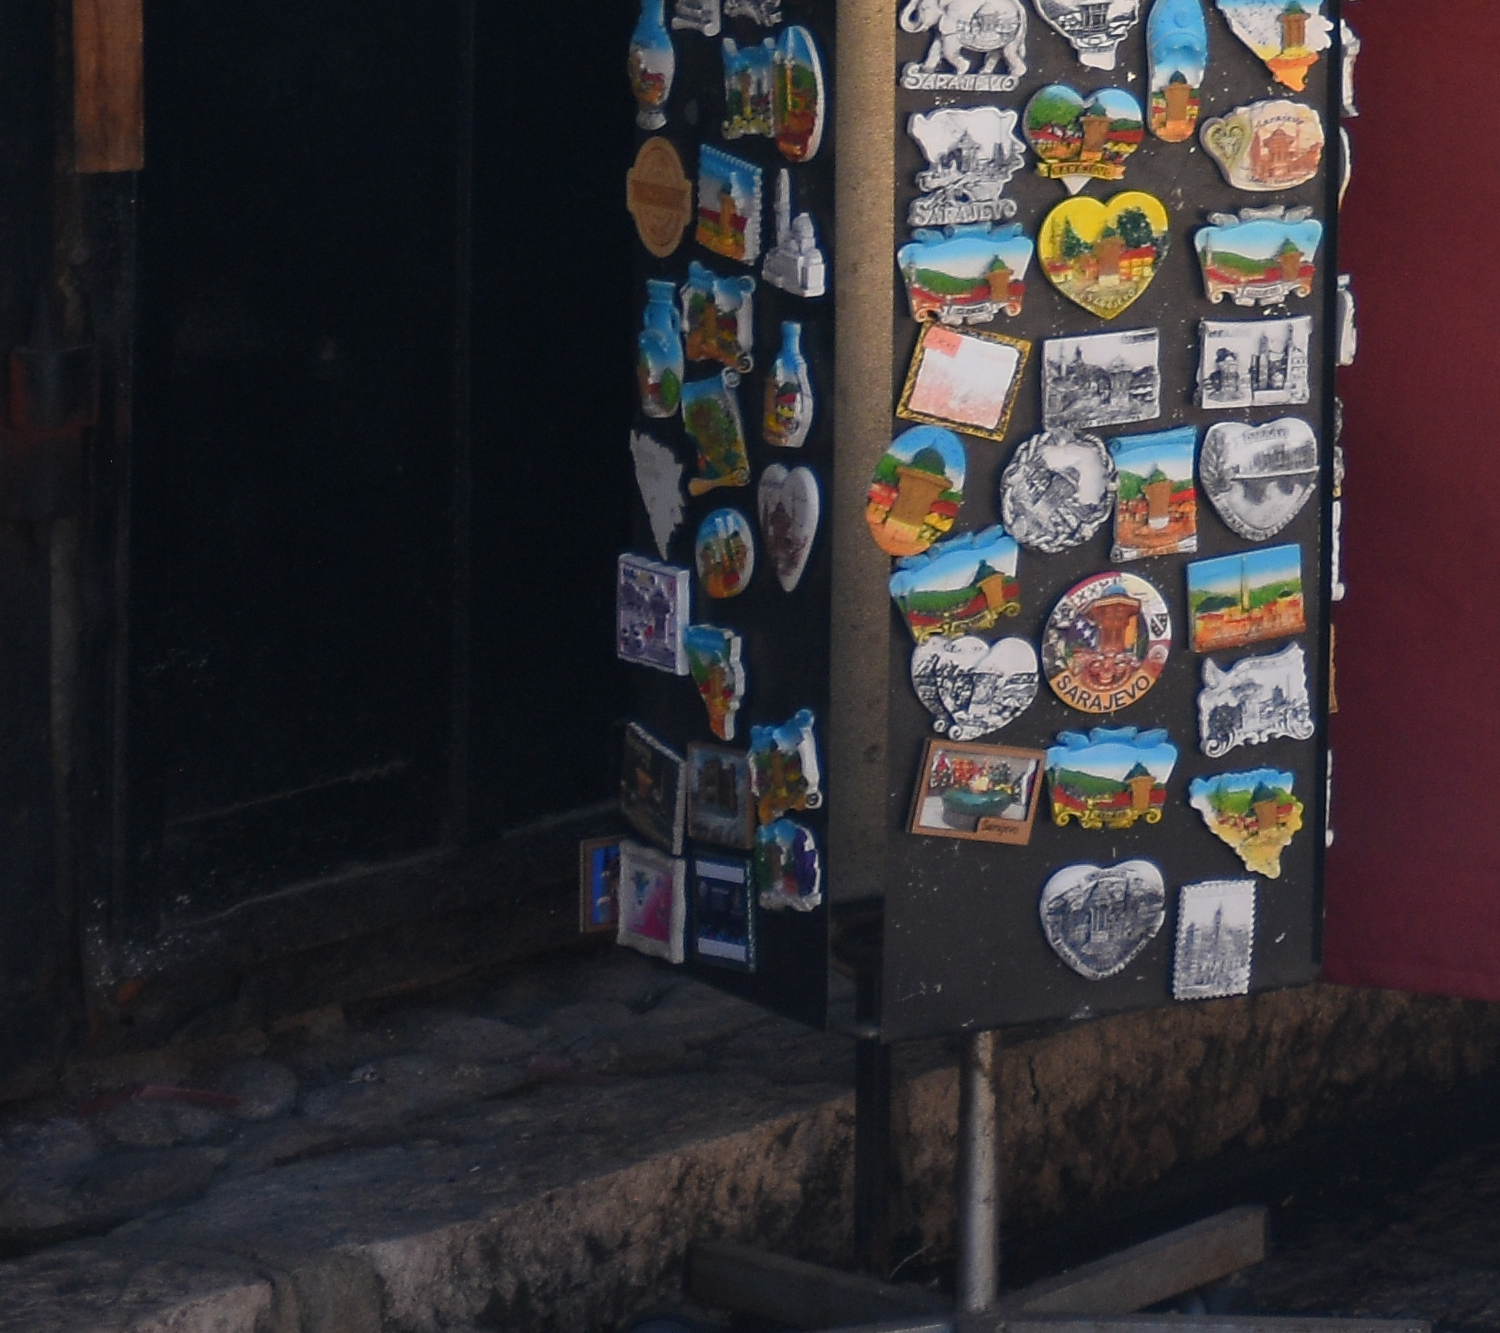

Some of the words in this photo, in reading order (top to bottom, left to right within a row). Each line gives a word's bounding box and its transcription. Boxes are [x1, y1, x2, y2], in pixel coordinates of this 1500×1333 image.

[905, 67, 1017, 92] SARAJEVO
[911, 197, 1017, 226] SARAJEVO
[1055, 672, 1149, 711] SARAJEVO
